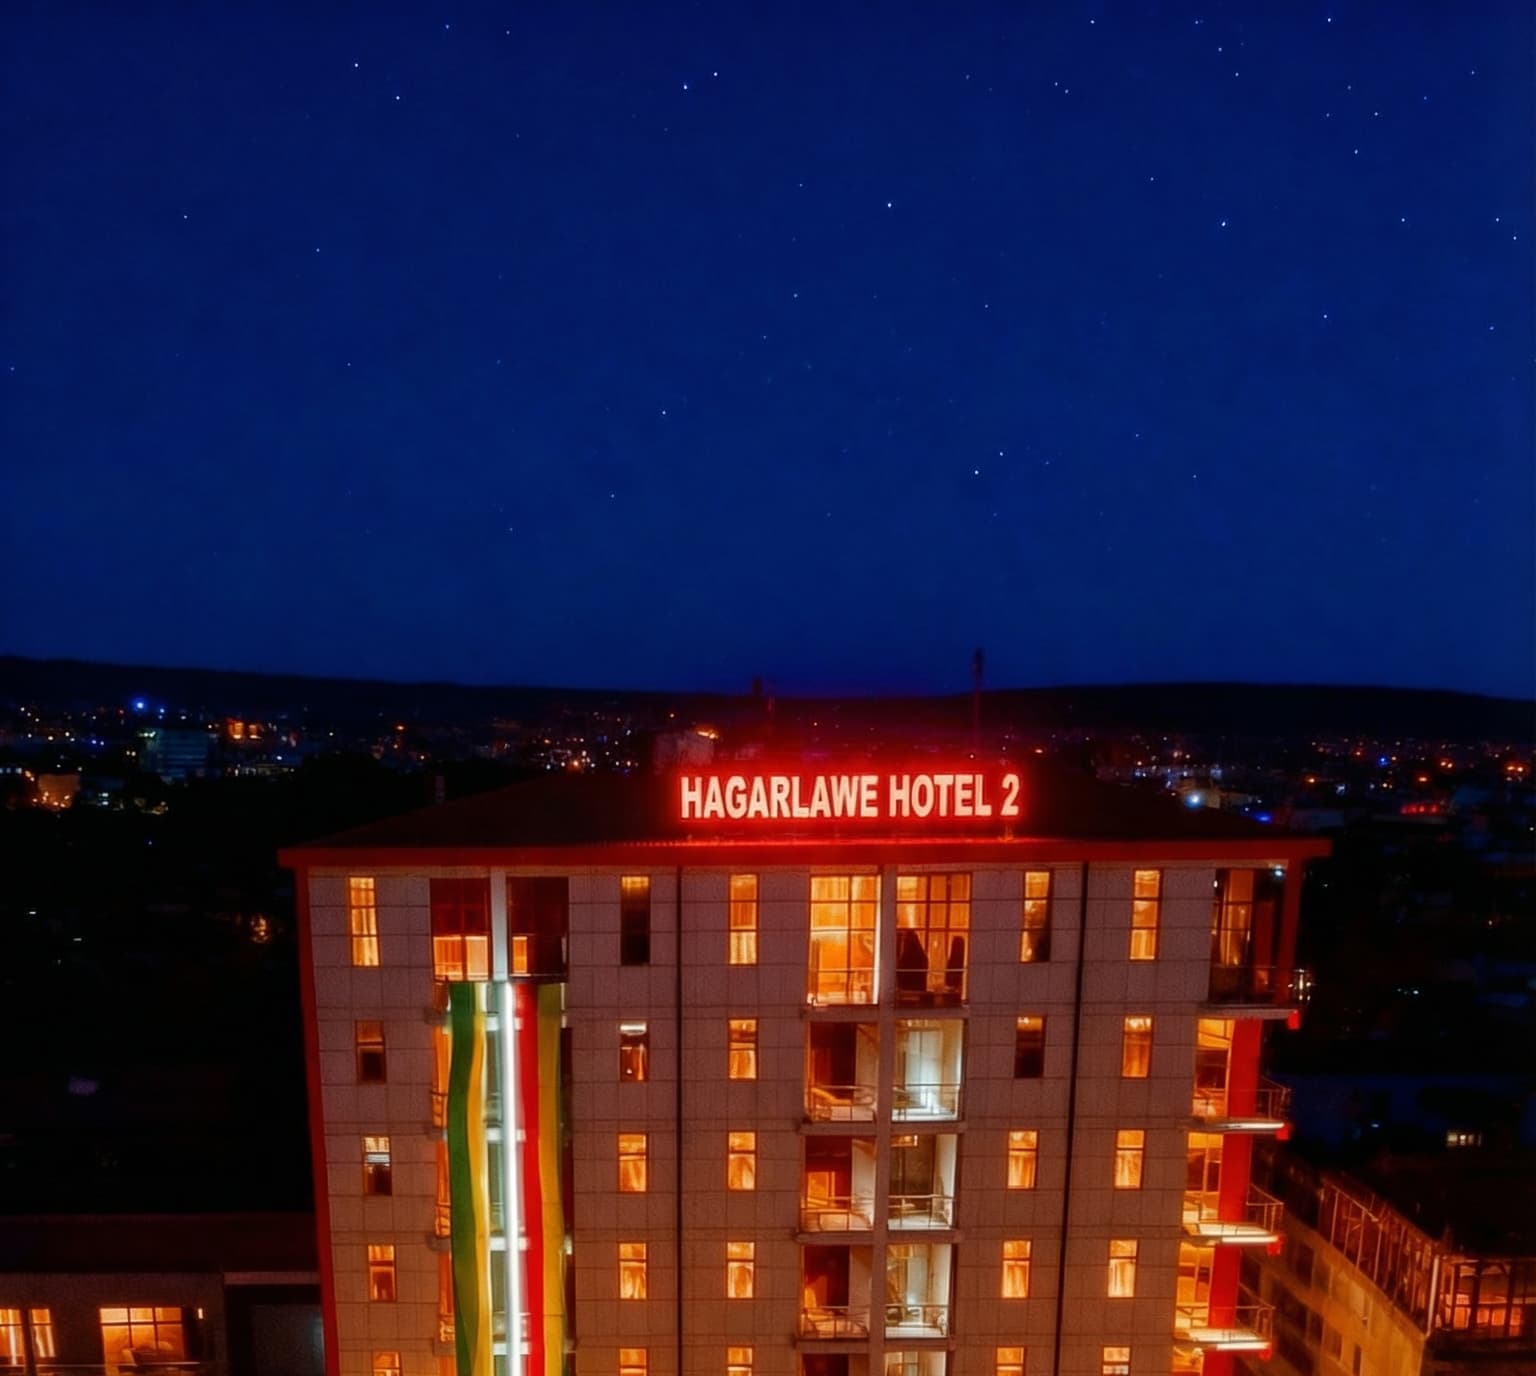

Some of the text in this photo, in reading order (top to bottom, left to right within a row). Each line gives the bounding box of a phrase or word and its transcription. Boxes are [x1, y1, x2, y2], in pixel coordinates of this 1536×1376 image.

[680, 773, 1020, 819] HAGARLAWE HOTEL 2
